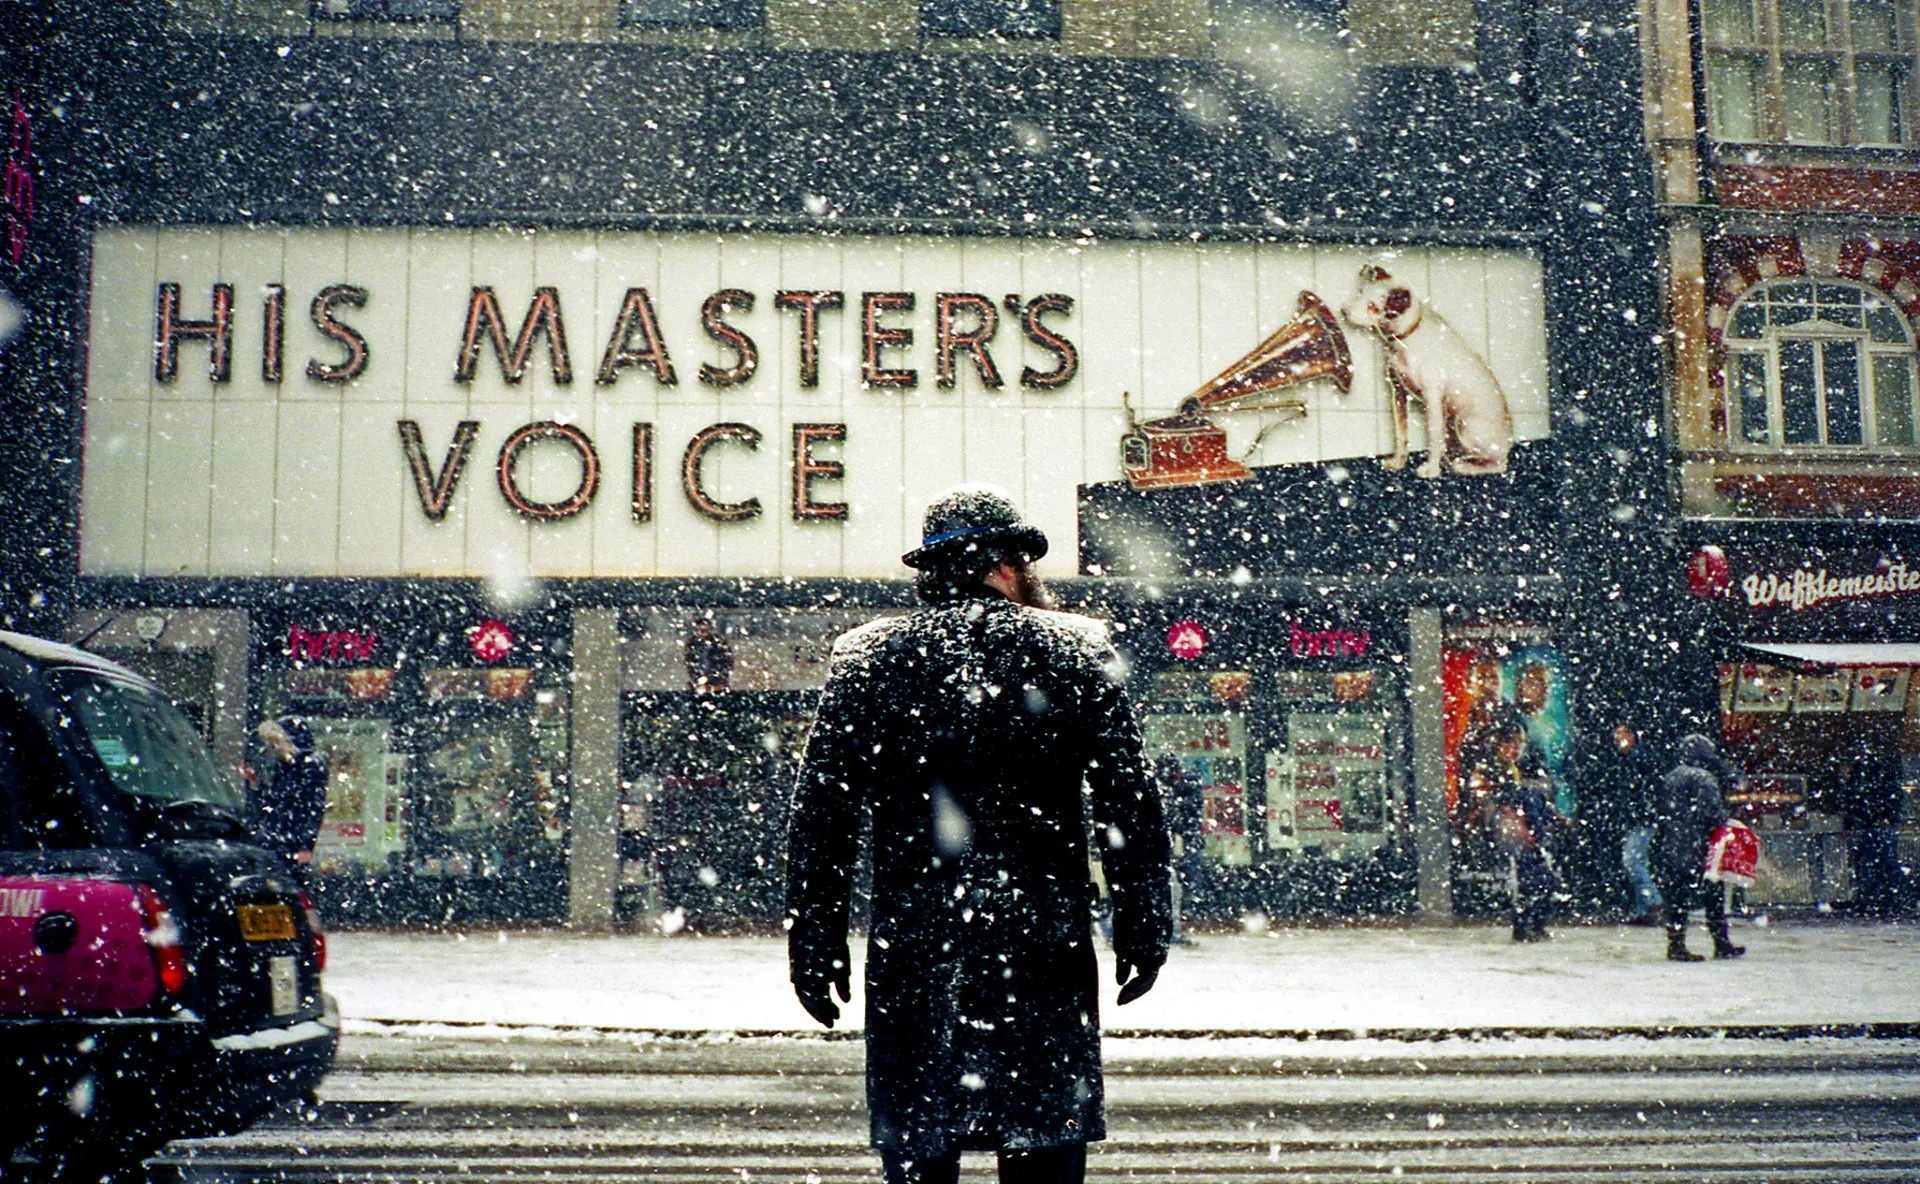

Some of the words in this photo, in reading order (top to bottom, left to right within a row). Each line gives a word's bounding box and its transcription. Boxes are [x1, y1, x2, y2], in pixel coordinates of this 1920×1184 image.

[154, 282, 371, 383] HIS
[453, 285, 1080, 390] MASTER'S
[397, 421, 848, 522] VOICE
[288, 622, 378, 660] hmv
[1290, 623, 1371, 657] hmv
